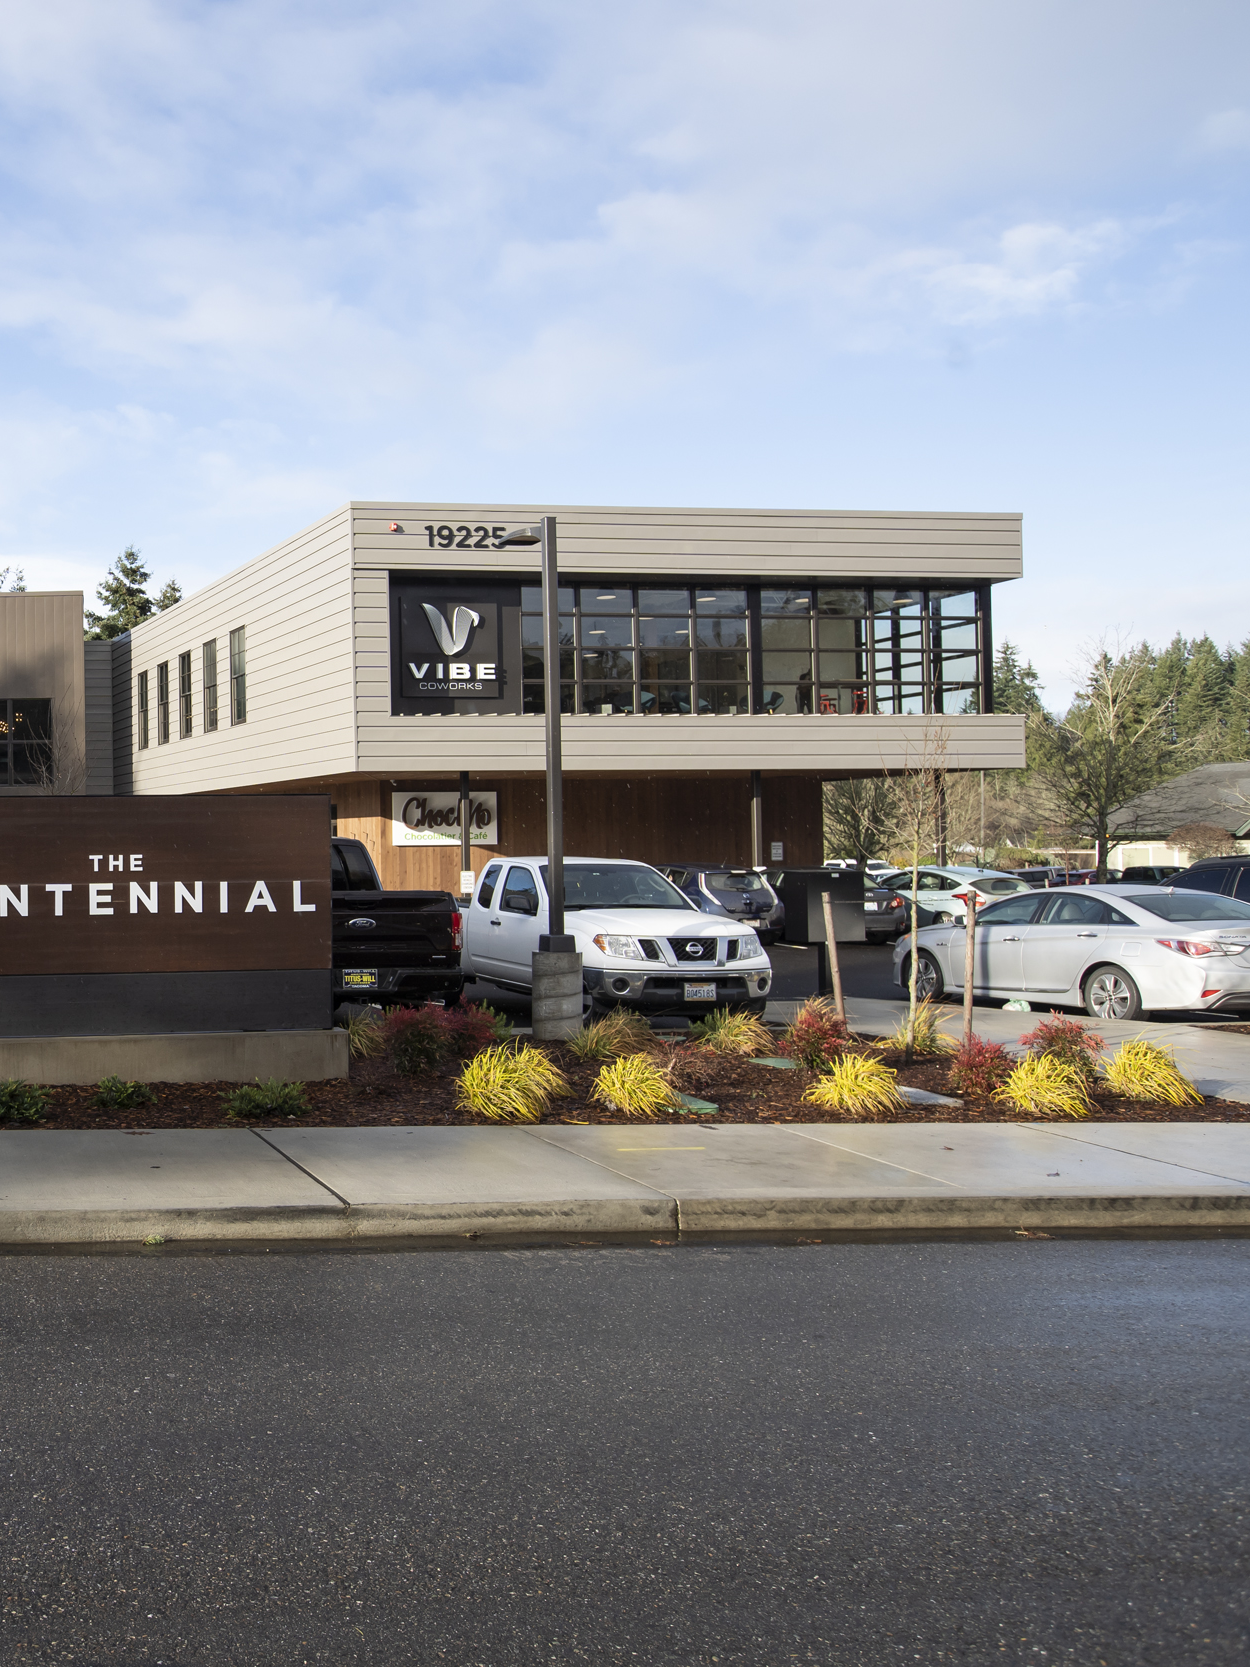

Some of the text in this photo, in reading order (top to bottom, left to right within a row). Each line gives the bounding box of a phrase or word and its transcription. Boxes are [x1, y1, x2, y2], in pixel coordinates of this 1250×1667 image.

[424, 525, 507, 549] 19225
[408, 663, 496, 680] VIBE
[419, 682, 483, 690] COWORKS
[404, 832, 456, 841] Chocolatier
[89, 854, 144, 872] THE
